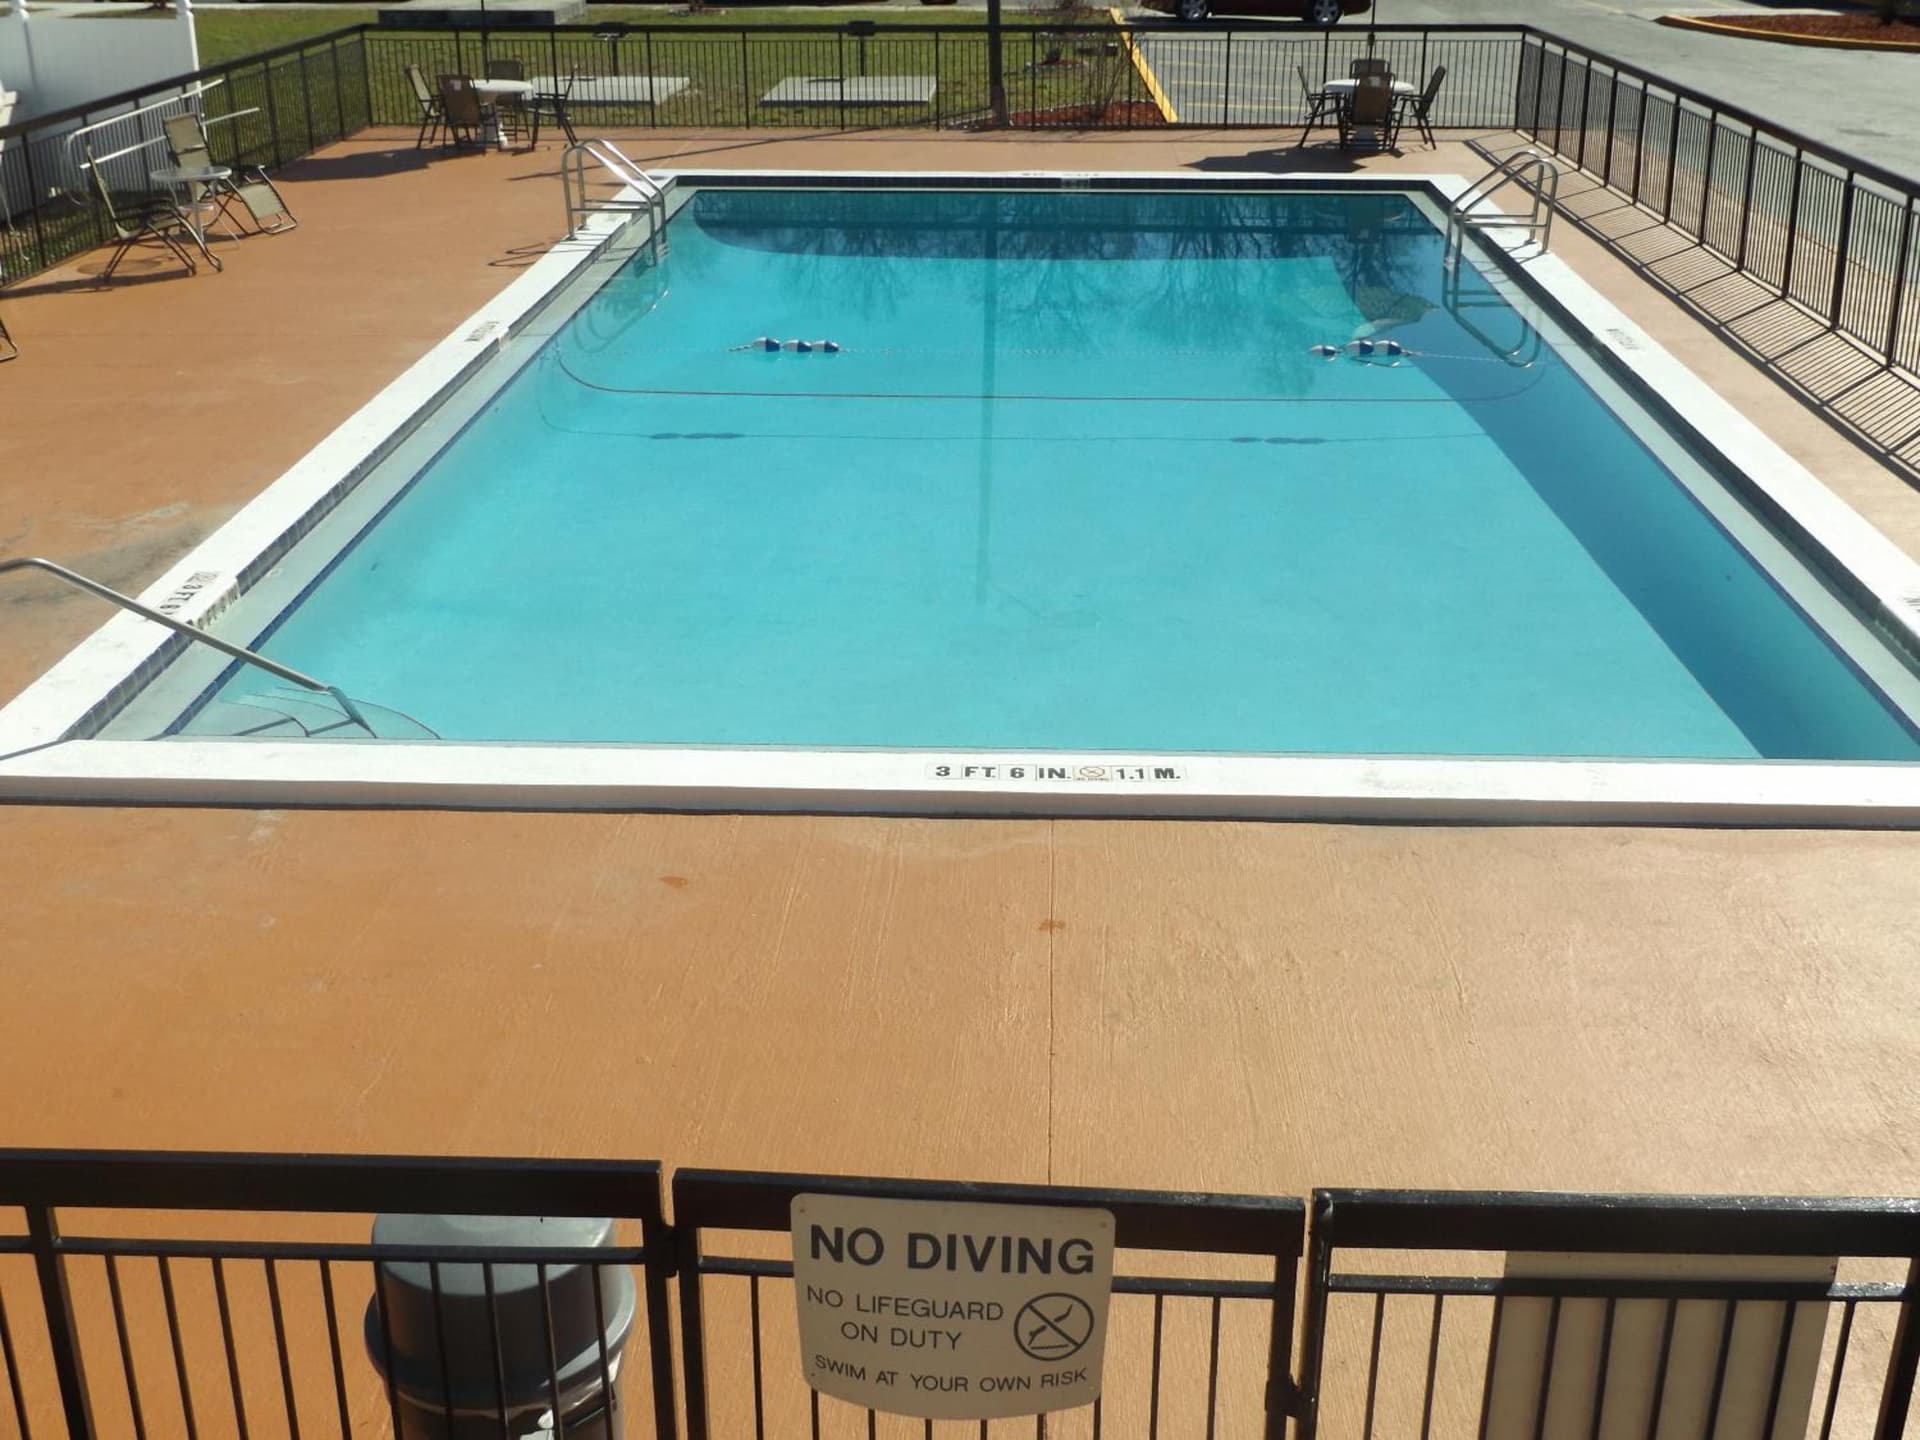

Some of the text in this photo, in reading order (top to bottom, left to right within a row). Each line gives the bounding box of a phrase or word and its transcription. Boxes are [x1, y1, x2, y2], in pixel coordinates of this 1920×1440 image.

[935, 765, 951, 777] 3
[1009, 767, 1025, 779] 6
[1038, 767, 1072, 780] IN.
[1115, 768, 1144, 780] 1.1
[1153, 767, 1182, 780] M.
[810, 1224, 1094, 1275] NO DIVING
[807, 1284, 1004, 1321] NO LIFEGUARD
[840, 1321, 962, 1350] ON DUTY
[815, 1354, 1087, 1392] SWIM AT YOUR OWN RISK
